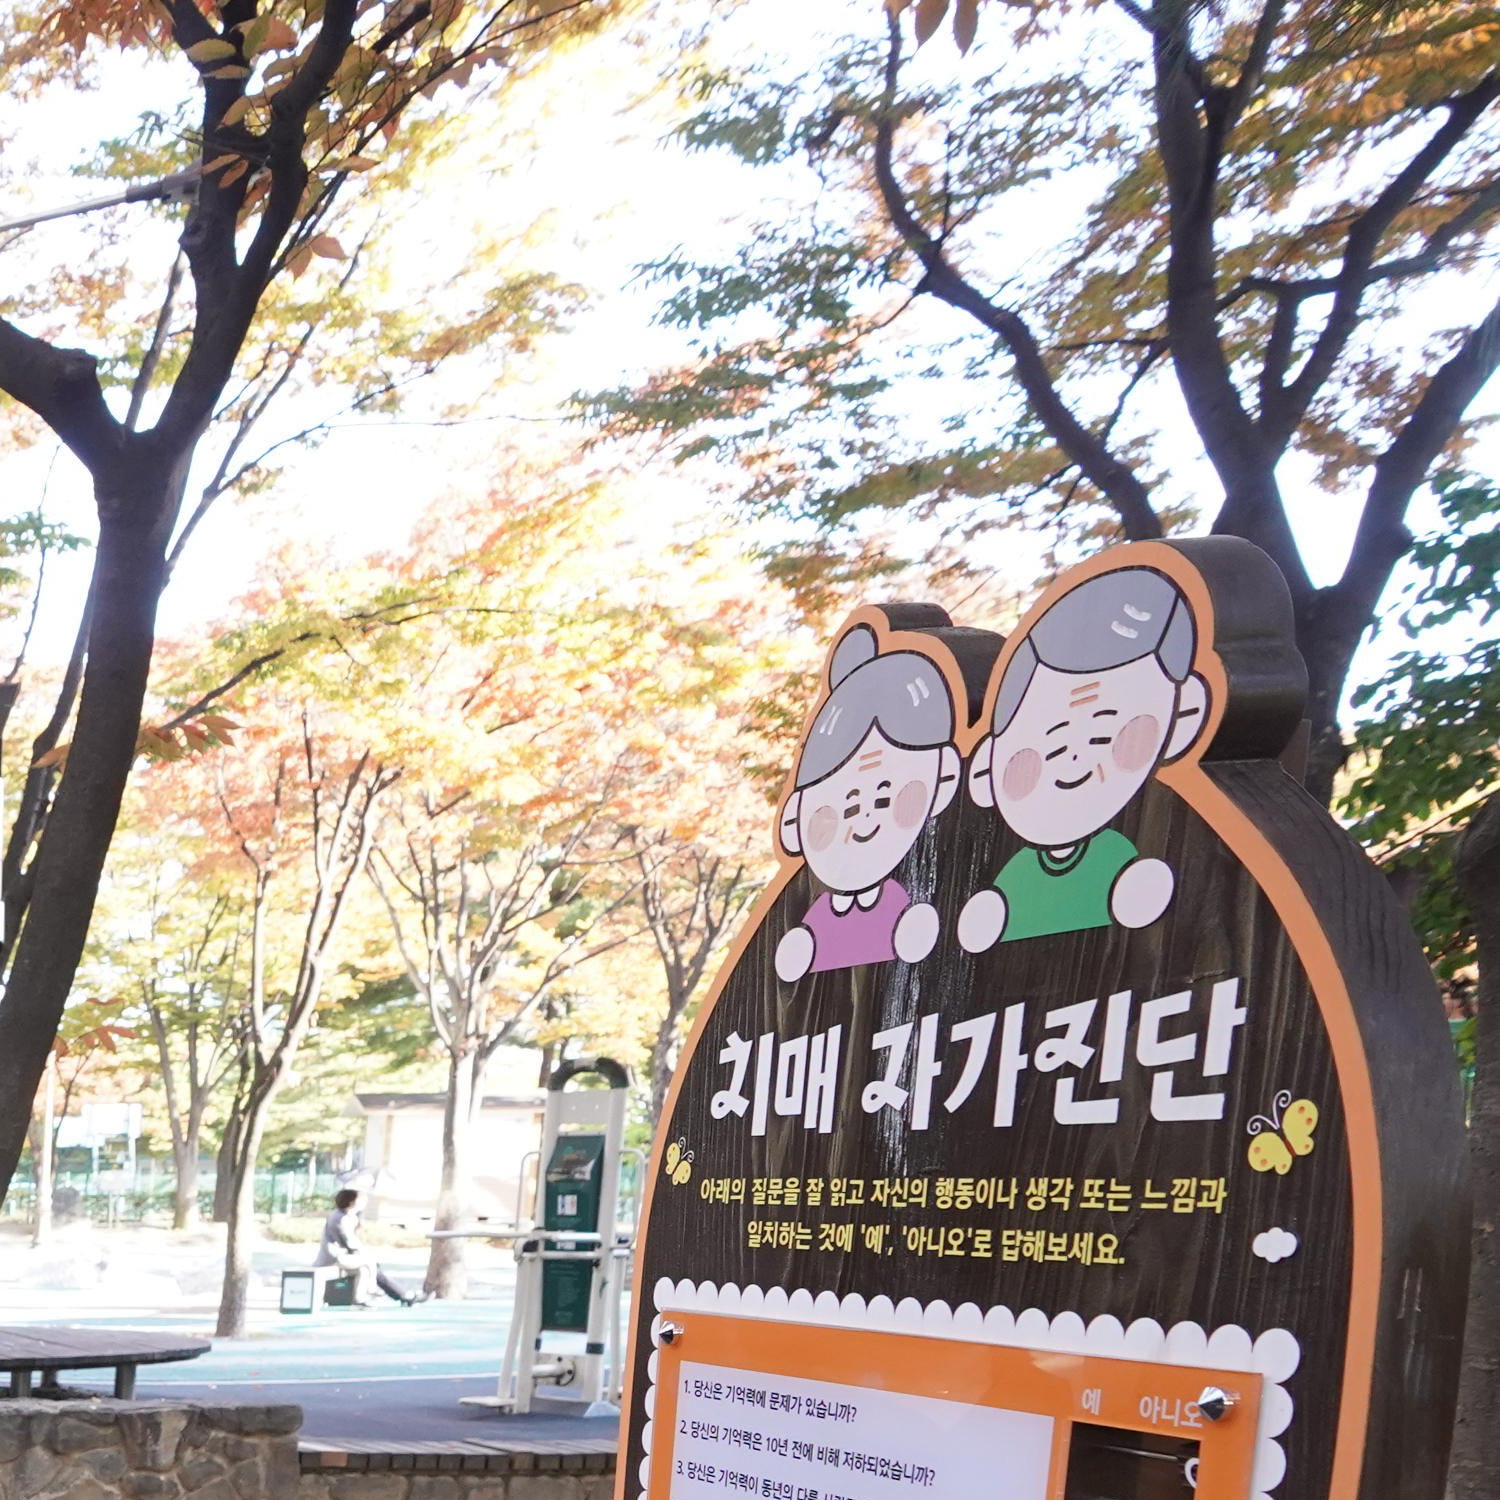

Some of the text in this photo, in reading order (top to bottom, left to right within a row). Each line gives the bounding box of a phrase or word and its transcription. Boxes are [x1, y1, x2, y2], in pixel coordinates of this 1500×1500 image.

[710, 976, 1248, 1137] 치매 자가진단
[700, 1177, 1228, 1214] 아래의 질문을 잘 읽고 자신의 행동이나 생각 또는 느낌과
[747, 1220, 1125, 1266] 일치하는 것에 '예', '아니오'로 답해보세요.
[683, 1378, 858, 1424] 1. 당신은 기억력에 문제가 있습니까?
[1081, 1388, 1101, 1415] 예
[1139, 1395, 1203, 1428] 아니오
[689, 1419, 720, 1443] 당신의
[720, 1426, 763, 1452] 기억력은
[765, 1435, 789, 1457] 10년
[790, 1439, 814, 1463] 전에
[815, 1445, 841, 1468] 비해
[841, 1450, 936, 1487] 저하되었습니까?
[675, 1459, 685, 1476] 3.
[686, 1460, 716, 1484] 당신은
[717, 1468, 759, 1495] 기억력이
